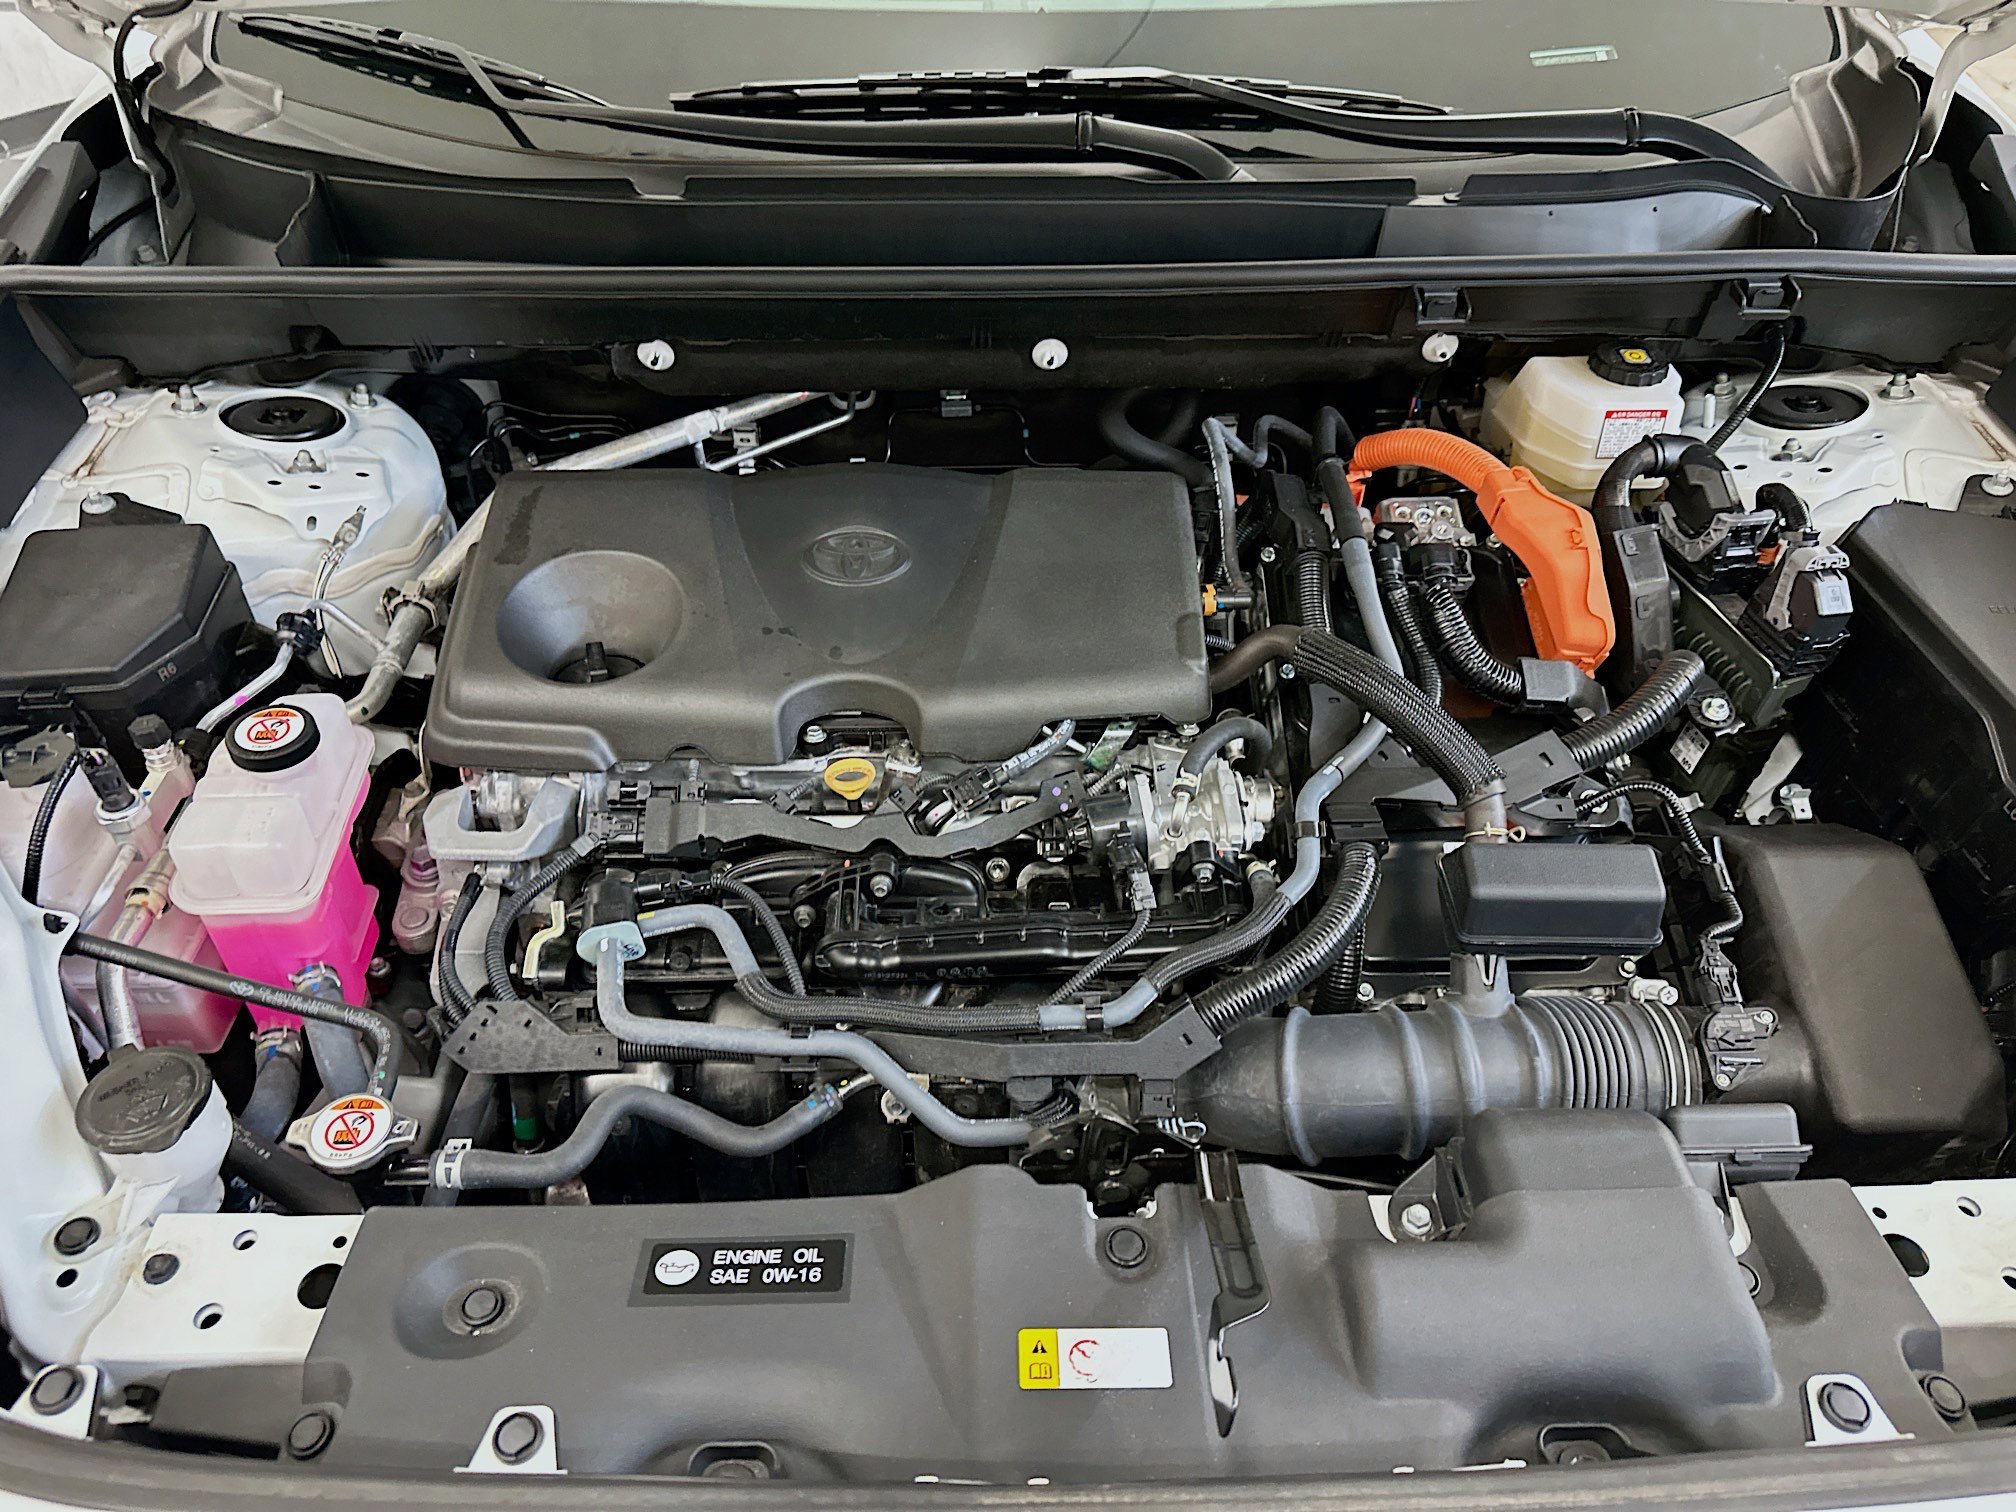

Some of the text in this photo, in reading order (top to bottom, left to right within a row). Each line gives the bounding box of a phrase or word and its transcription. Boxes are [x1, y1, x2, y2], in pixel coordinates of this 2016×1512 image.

[713, 1248, 825, 1265] ENGINE OIL
[709, 1267, 822, 1284] SAE 0W-16
